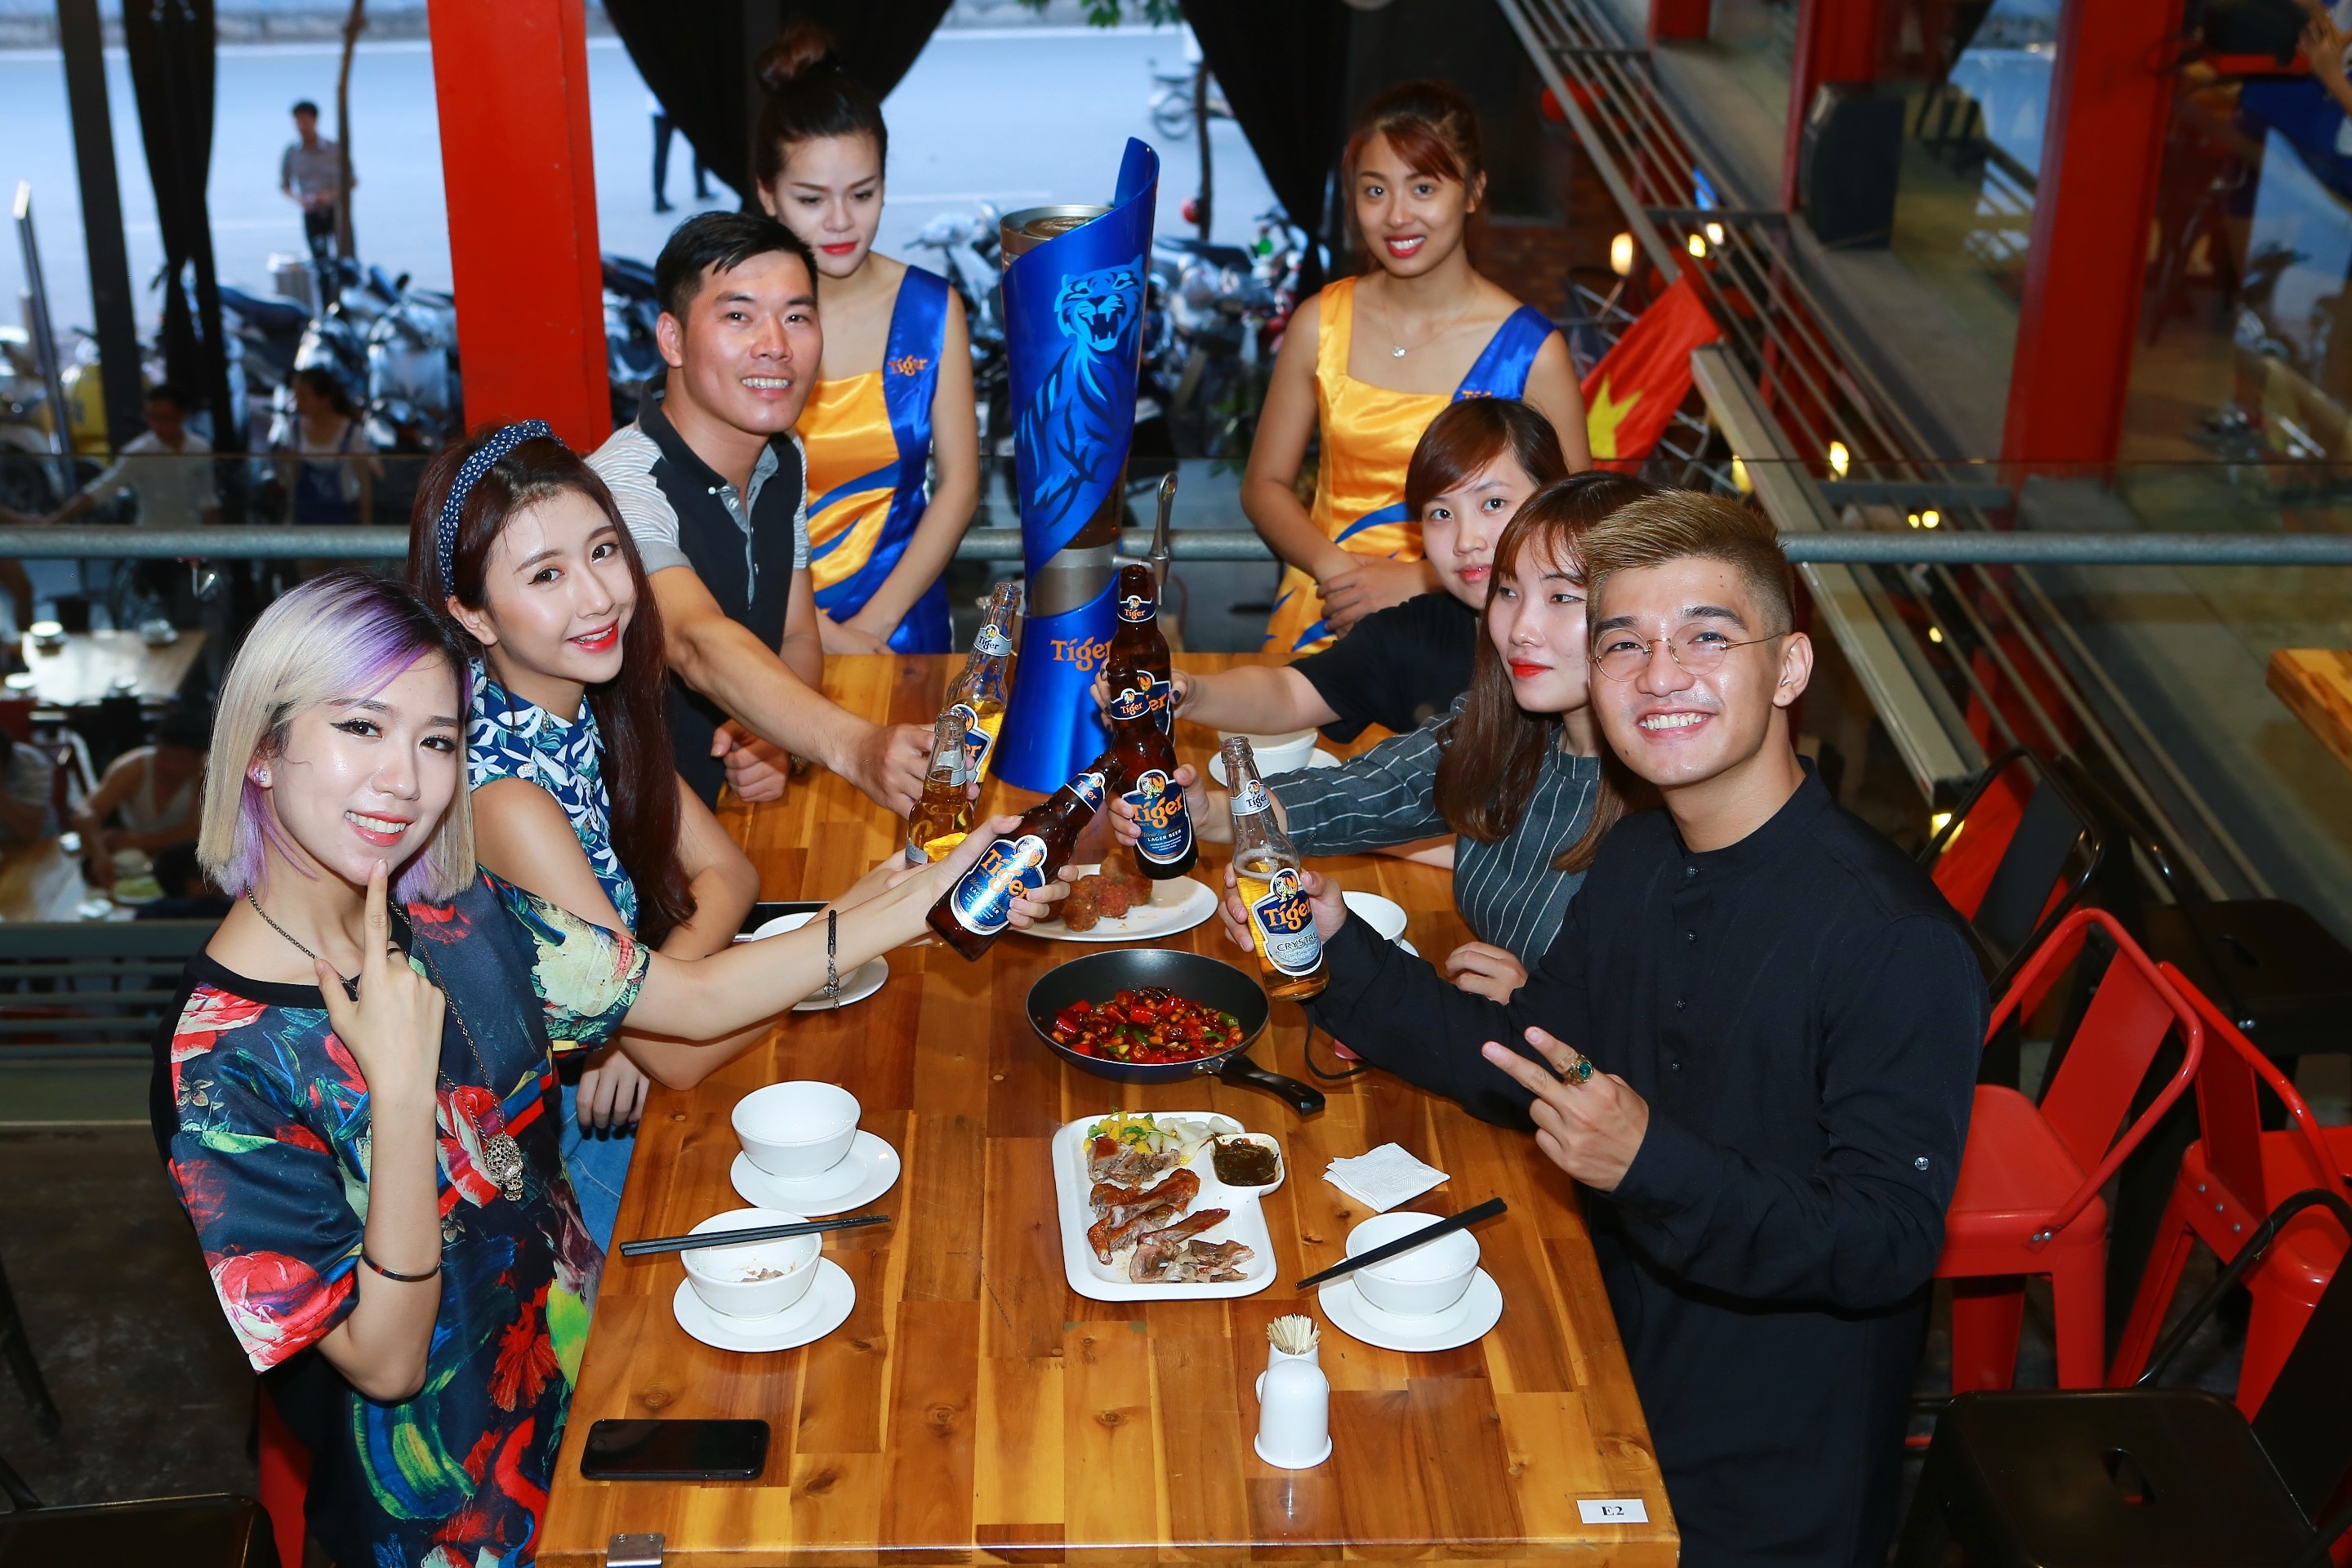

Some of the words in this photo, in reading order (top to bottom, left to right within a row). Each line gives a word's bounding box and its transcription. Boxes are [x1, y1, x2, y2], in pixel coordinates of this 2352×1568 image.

[888, 354, 928, 376] Tiger
[1124, 608, 1146, 620] Tiger
[979, 636, 1000, 650] Tiger
[1120, 702, 1143, 715] Tiger
[1246, 794, 1267, 808] Tiger
[1131, 793, 1183, 829] Tiger
[1169, 829, 1182, 838] BEER
[1263, 898, 1311, 930] Tiger
[1276, 932, 1317, 951] CRYSTAL
[1601, 1506, 1624, 1516] E2
